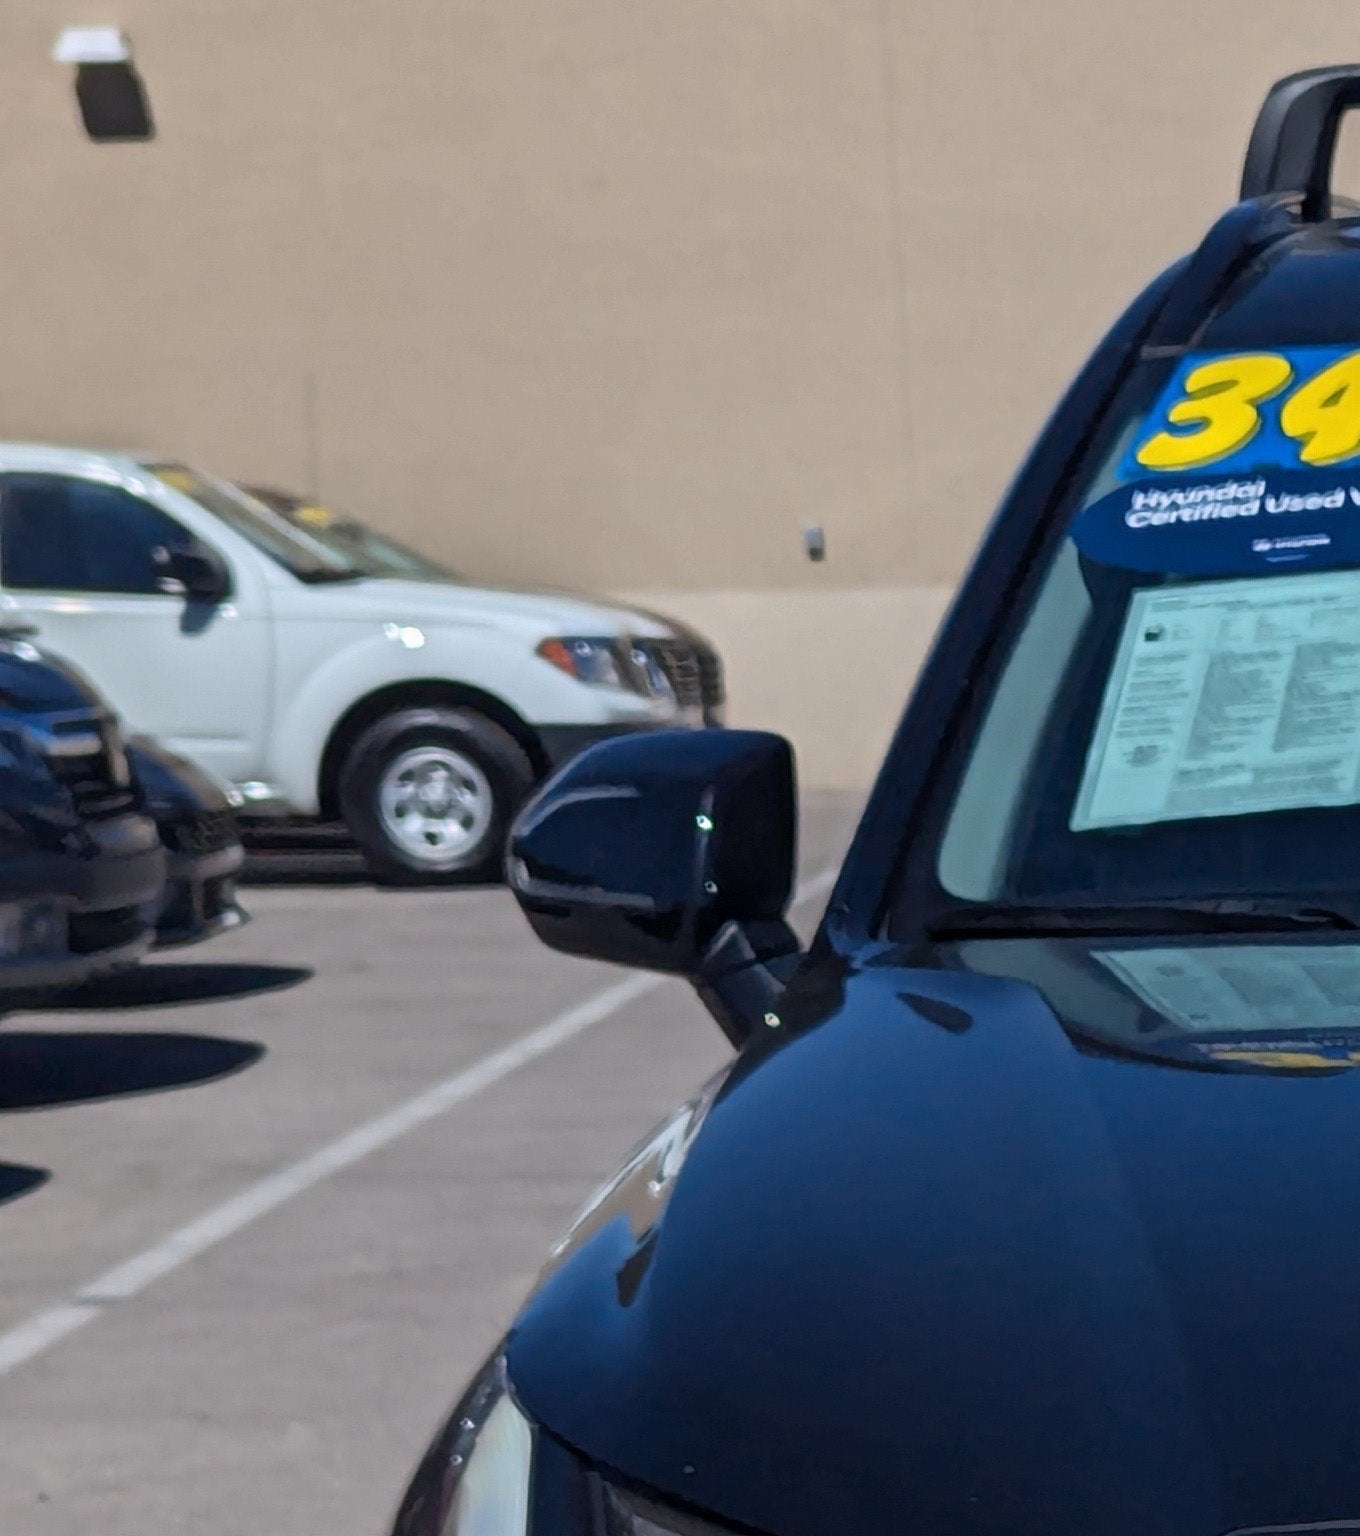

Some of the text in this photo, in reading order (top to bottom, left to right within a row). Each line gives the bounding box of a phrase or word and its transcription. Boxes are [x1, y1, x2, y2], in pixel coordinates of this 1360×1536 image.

[1125, 497, 1260, 528] Certified
[1265, 487, 1345, 513] Used
[1131, 476, 1266, 512] Hyundai
